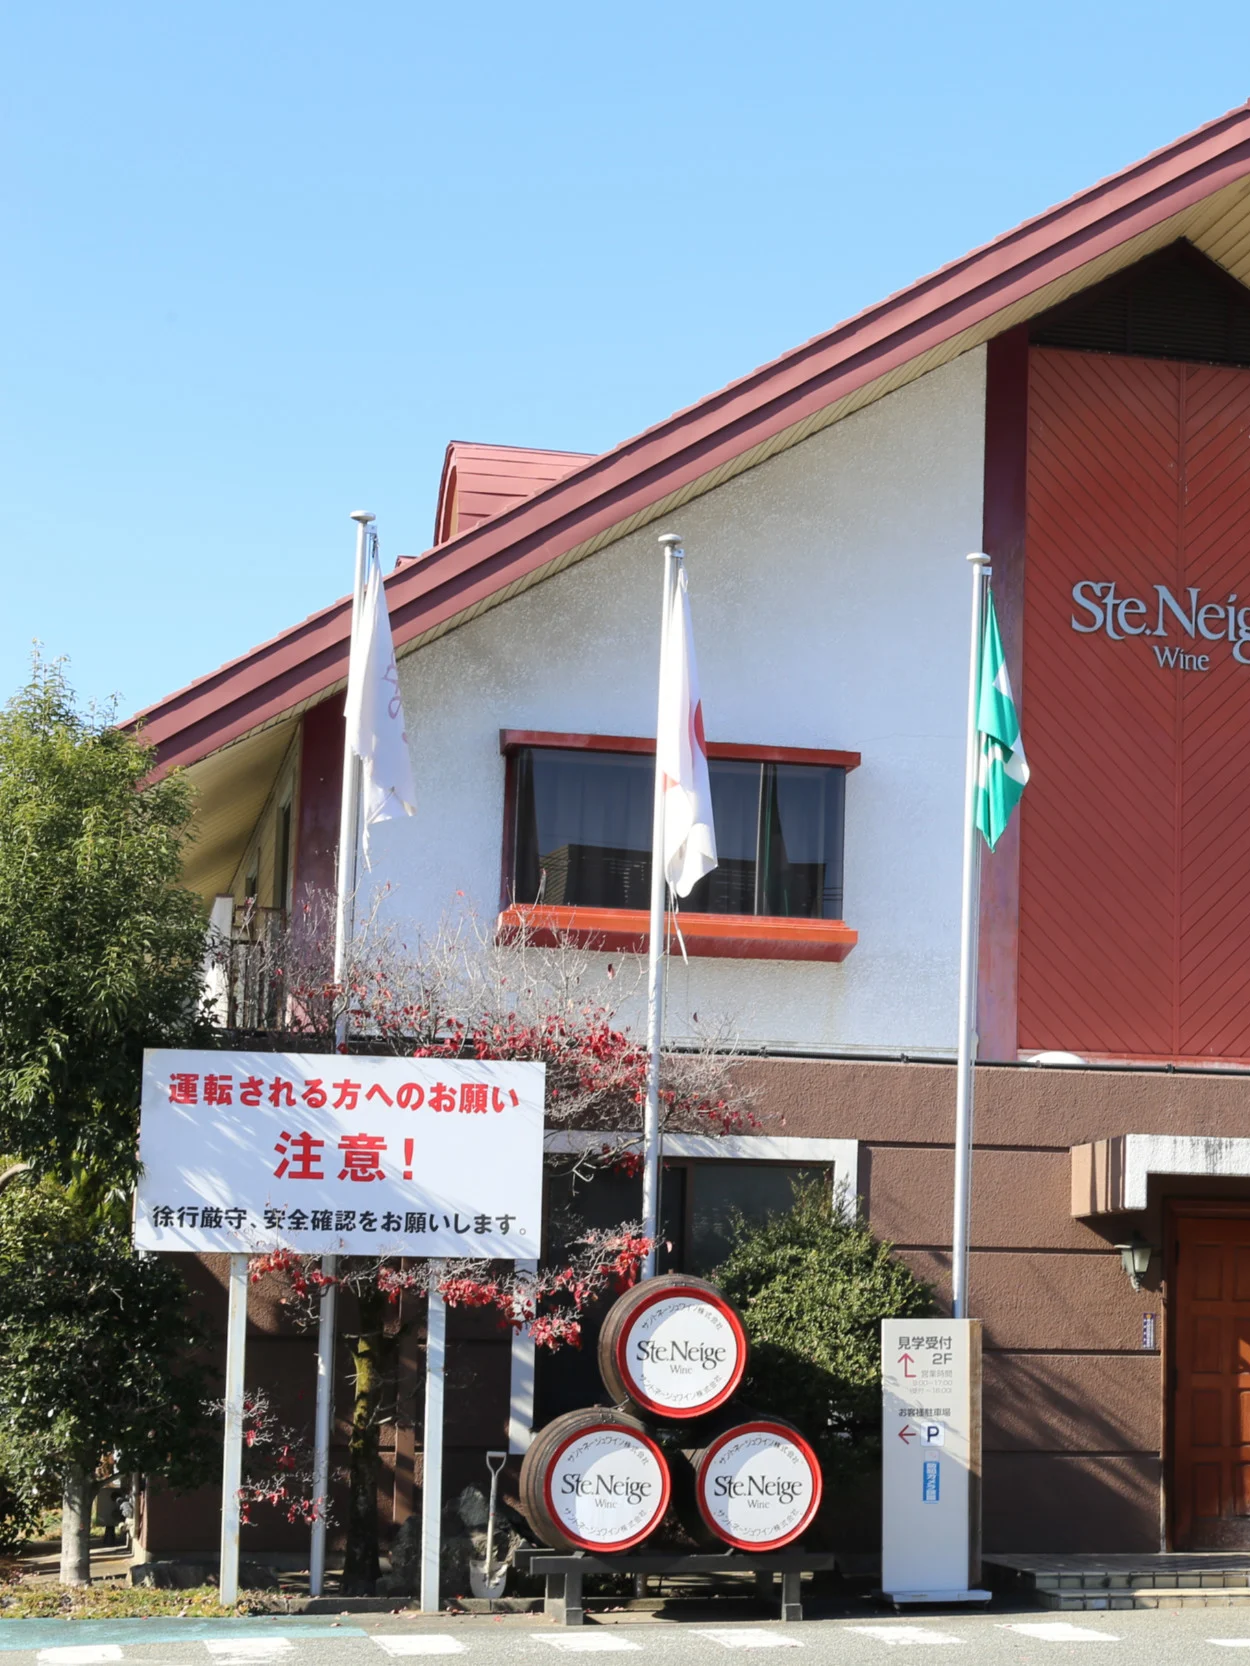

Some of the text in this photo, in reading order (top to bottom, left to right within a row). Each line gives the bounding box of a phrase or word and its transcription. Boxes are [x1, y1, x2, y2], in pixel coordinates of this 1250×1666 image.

[1153, 645, 1210, 671] Wine
[168, 1073, 519, 1114] 運転される方へのお願い
[152, 1205, 527, 1236] 徐行厳守、安全確認をお願いします。
[898, 1336, 952, 1350] 見学受付
[636, 1340, 727, 1370] Ste.Neige
[932, 1353, 952, 1365] 2F
[669, 1364, 693, 1374] Wine
[898, 1408, 951, 1417] お客様駐車場
[927, 1426, 940, 1442] P
[561, 1474, 652, 1505] Ste.Neige
[714, 1475, 803, 1504] Ste.Neige
[594, 1498, 618, 1509] Wine
[747, 1499, 771, 1509] Wine
